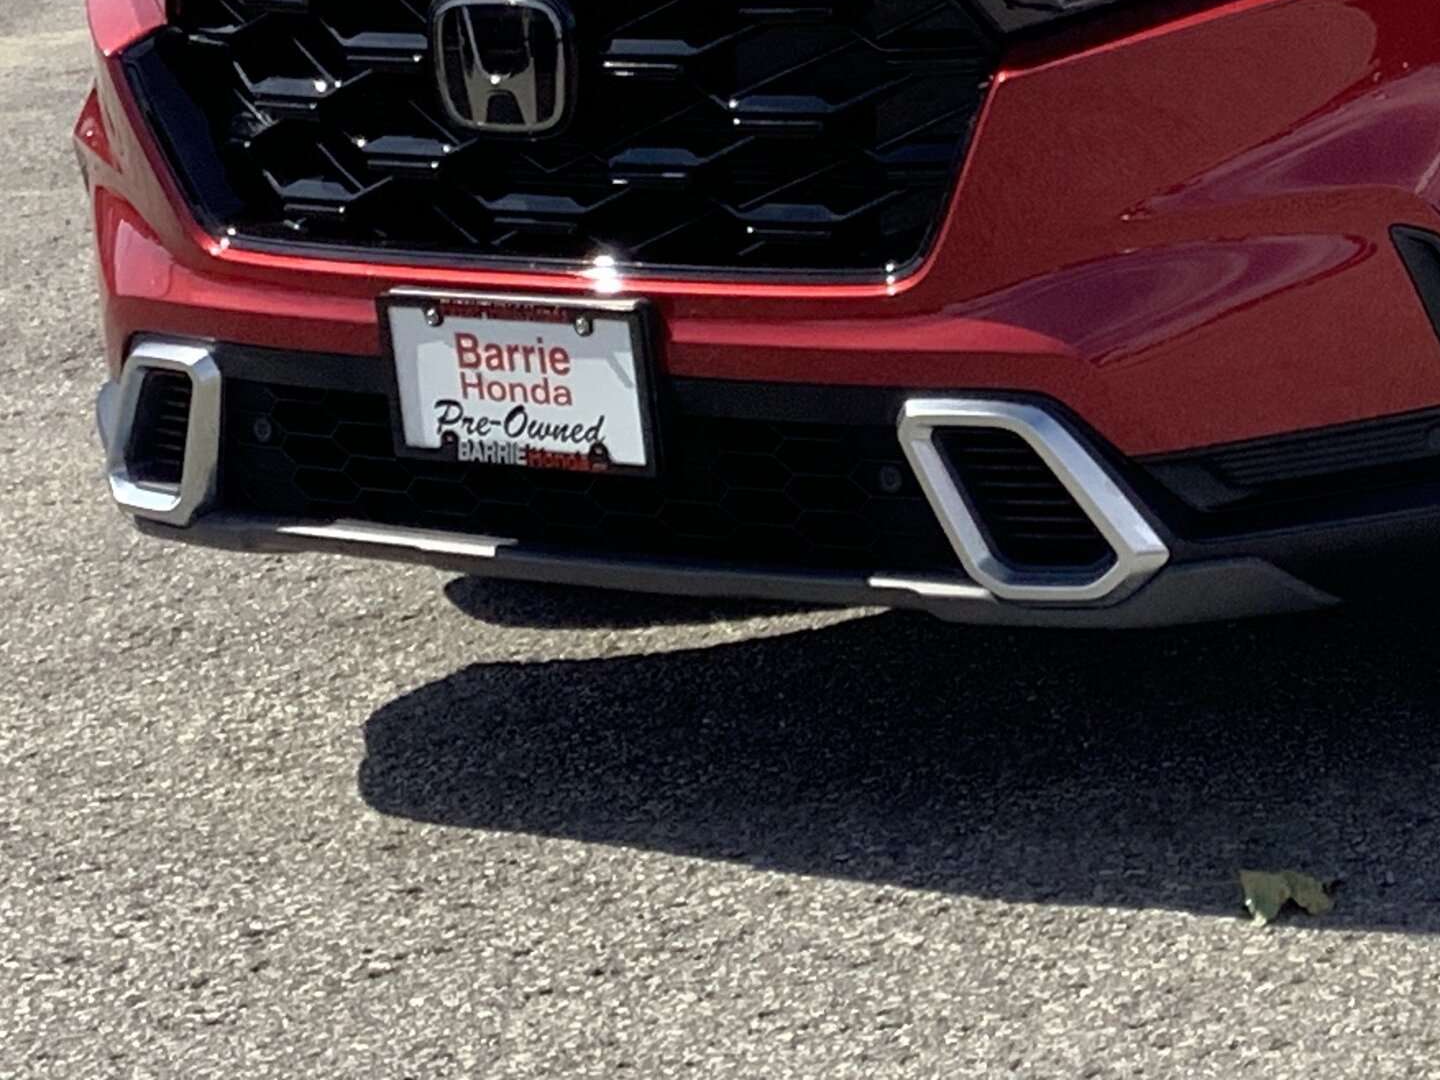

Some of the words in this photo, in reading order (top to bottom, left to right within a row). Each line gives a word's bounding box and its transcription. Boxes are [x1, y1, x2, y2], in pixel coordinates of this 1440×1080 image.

[453, 332, 571, 375] Barrie
[460, 372, 573, 406] Honda
[434, 399, 605, 443] Pre-Owned
[457, 439, 527, 466] BARRIE
